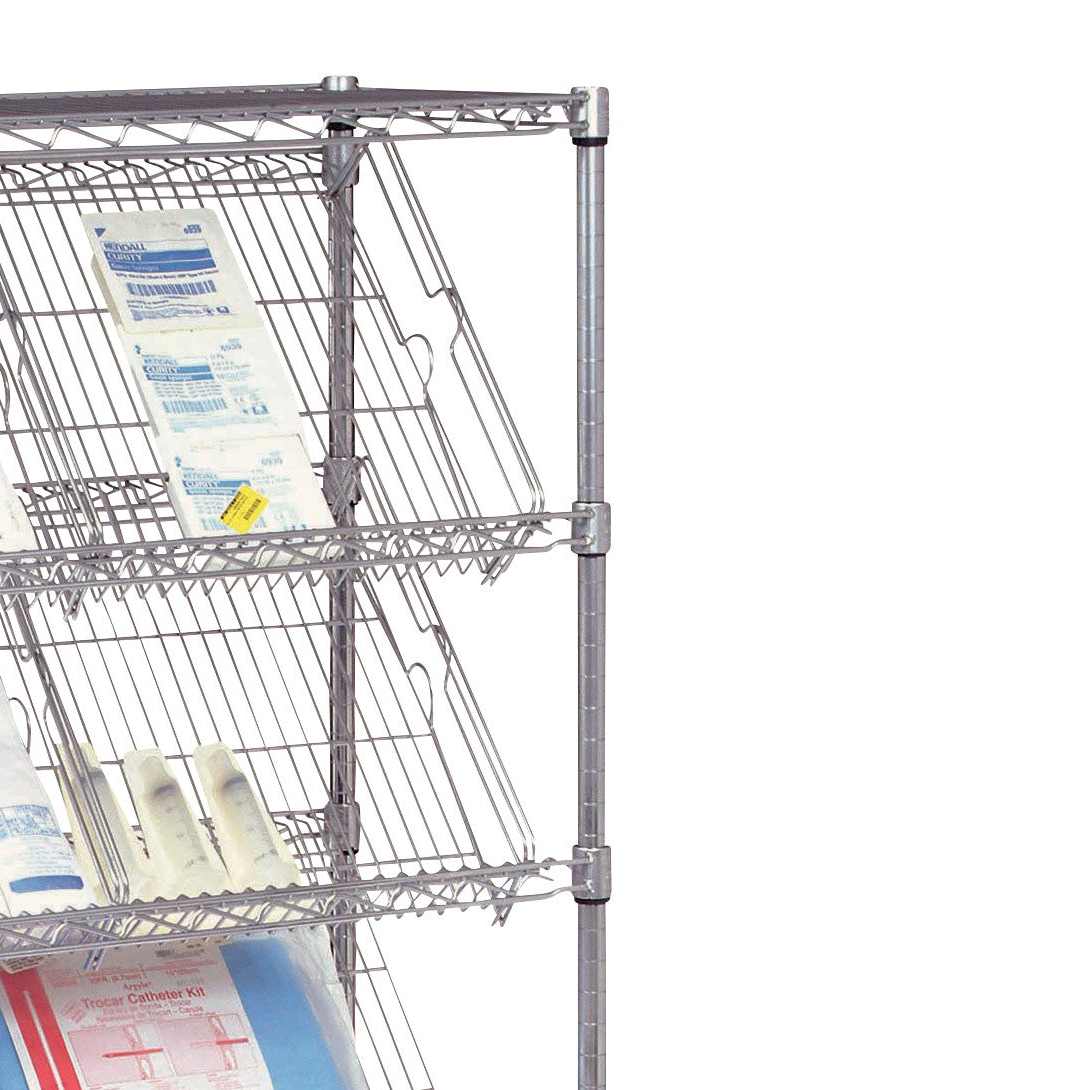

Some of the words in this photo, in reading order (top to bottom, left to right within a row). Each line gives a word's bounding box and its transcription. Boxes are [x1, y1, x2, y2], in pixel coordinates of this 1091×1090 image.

[104, 242, 147, 251] KENDALL
[106, 252, 142, 261] CURITY
[81, 996, 124, 1010] Trocar
[128, 989, 183, 1005] Catheter
[186, 985, 206, 998] Kit
